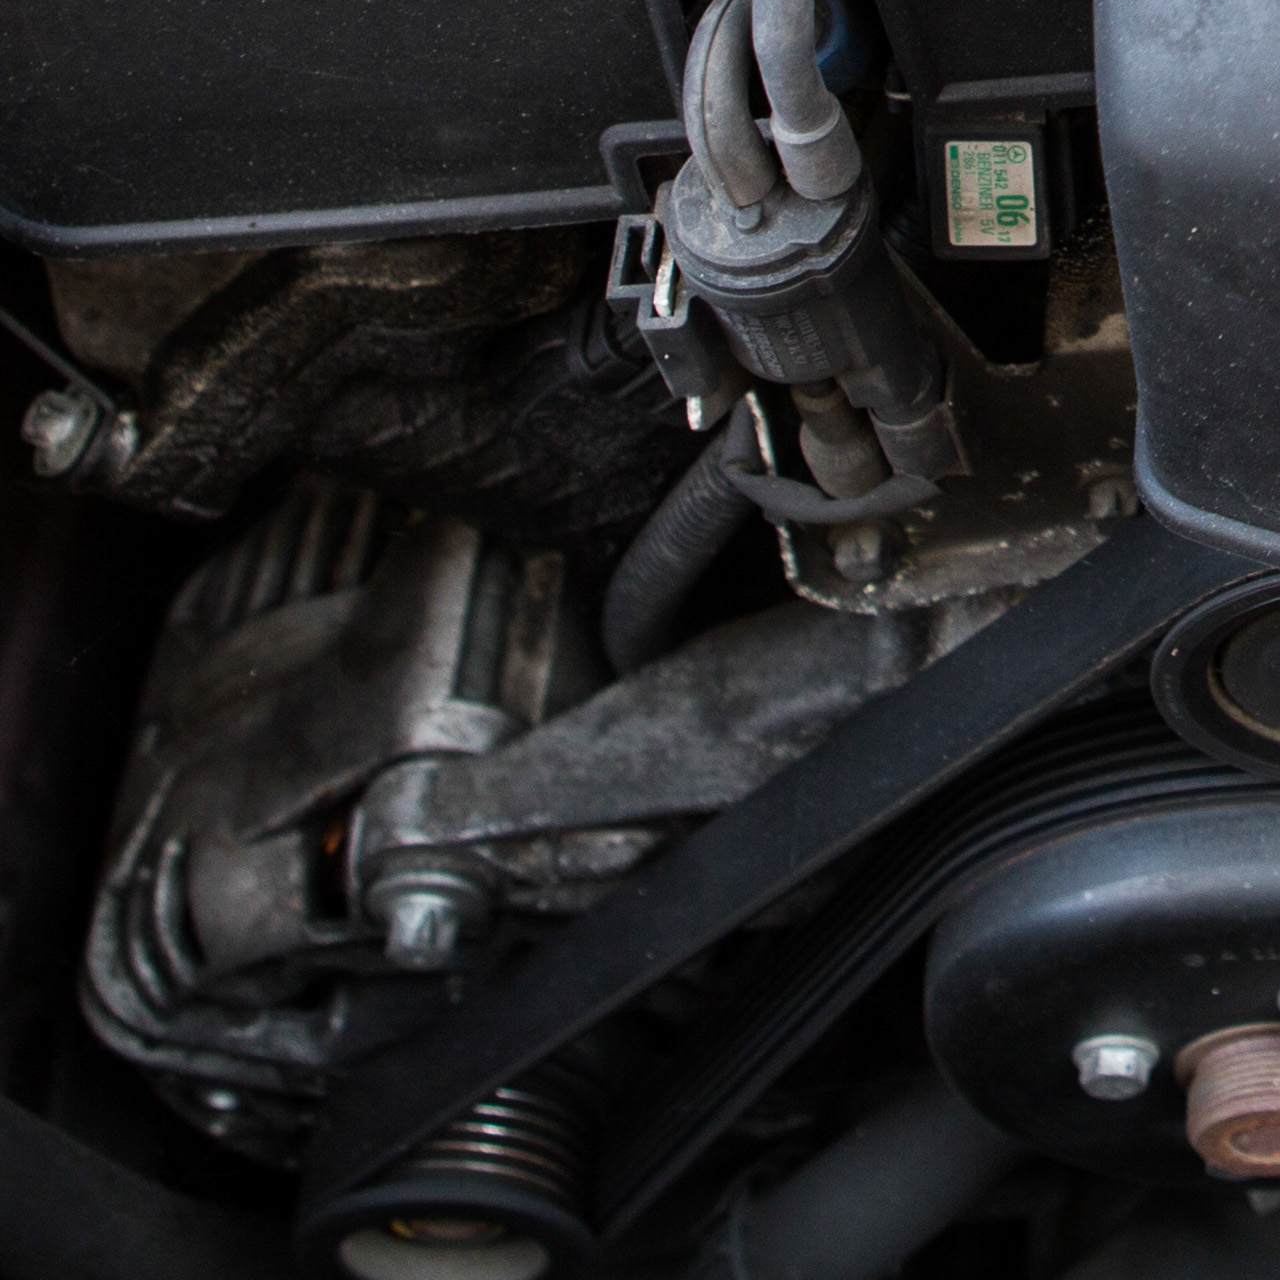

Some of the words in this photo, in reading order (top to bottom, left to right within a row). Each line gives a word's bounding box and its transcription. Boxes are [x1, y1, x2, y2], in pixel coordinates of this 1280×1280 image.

[976, 152, 994, 211] BENZINER
[979, 218, 995, 236] 5V
[995, 194, 1030, 227] 06
